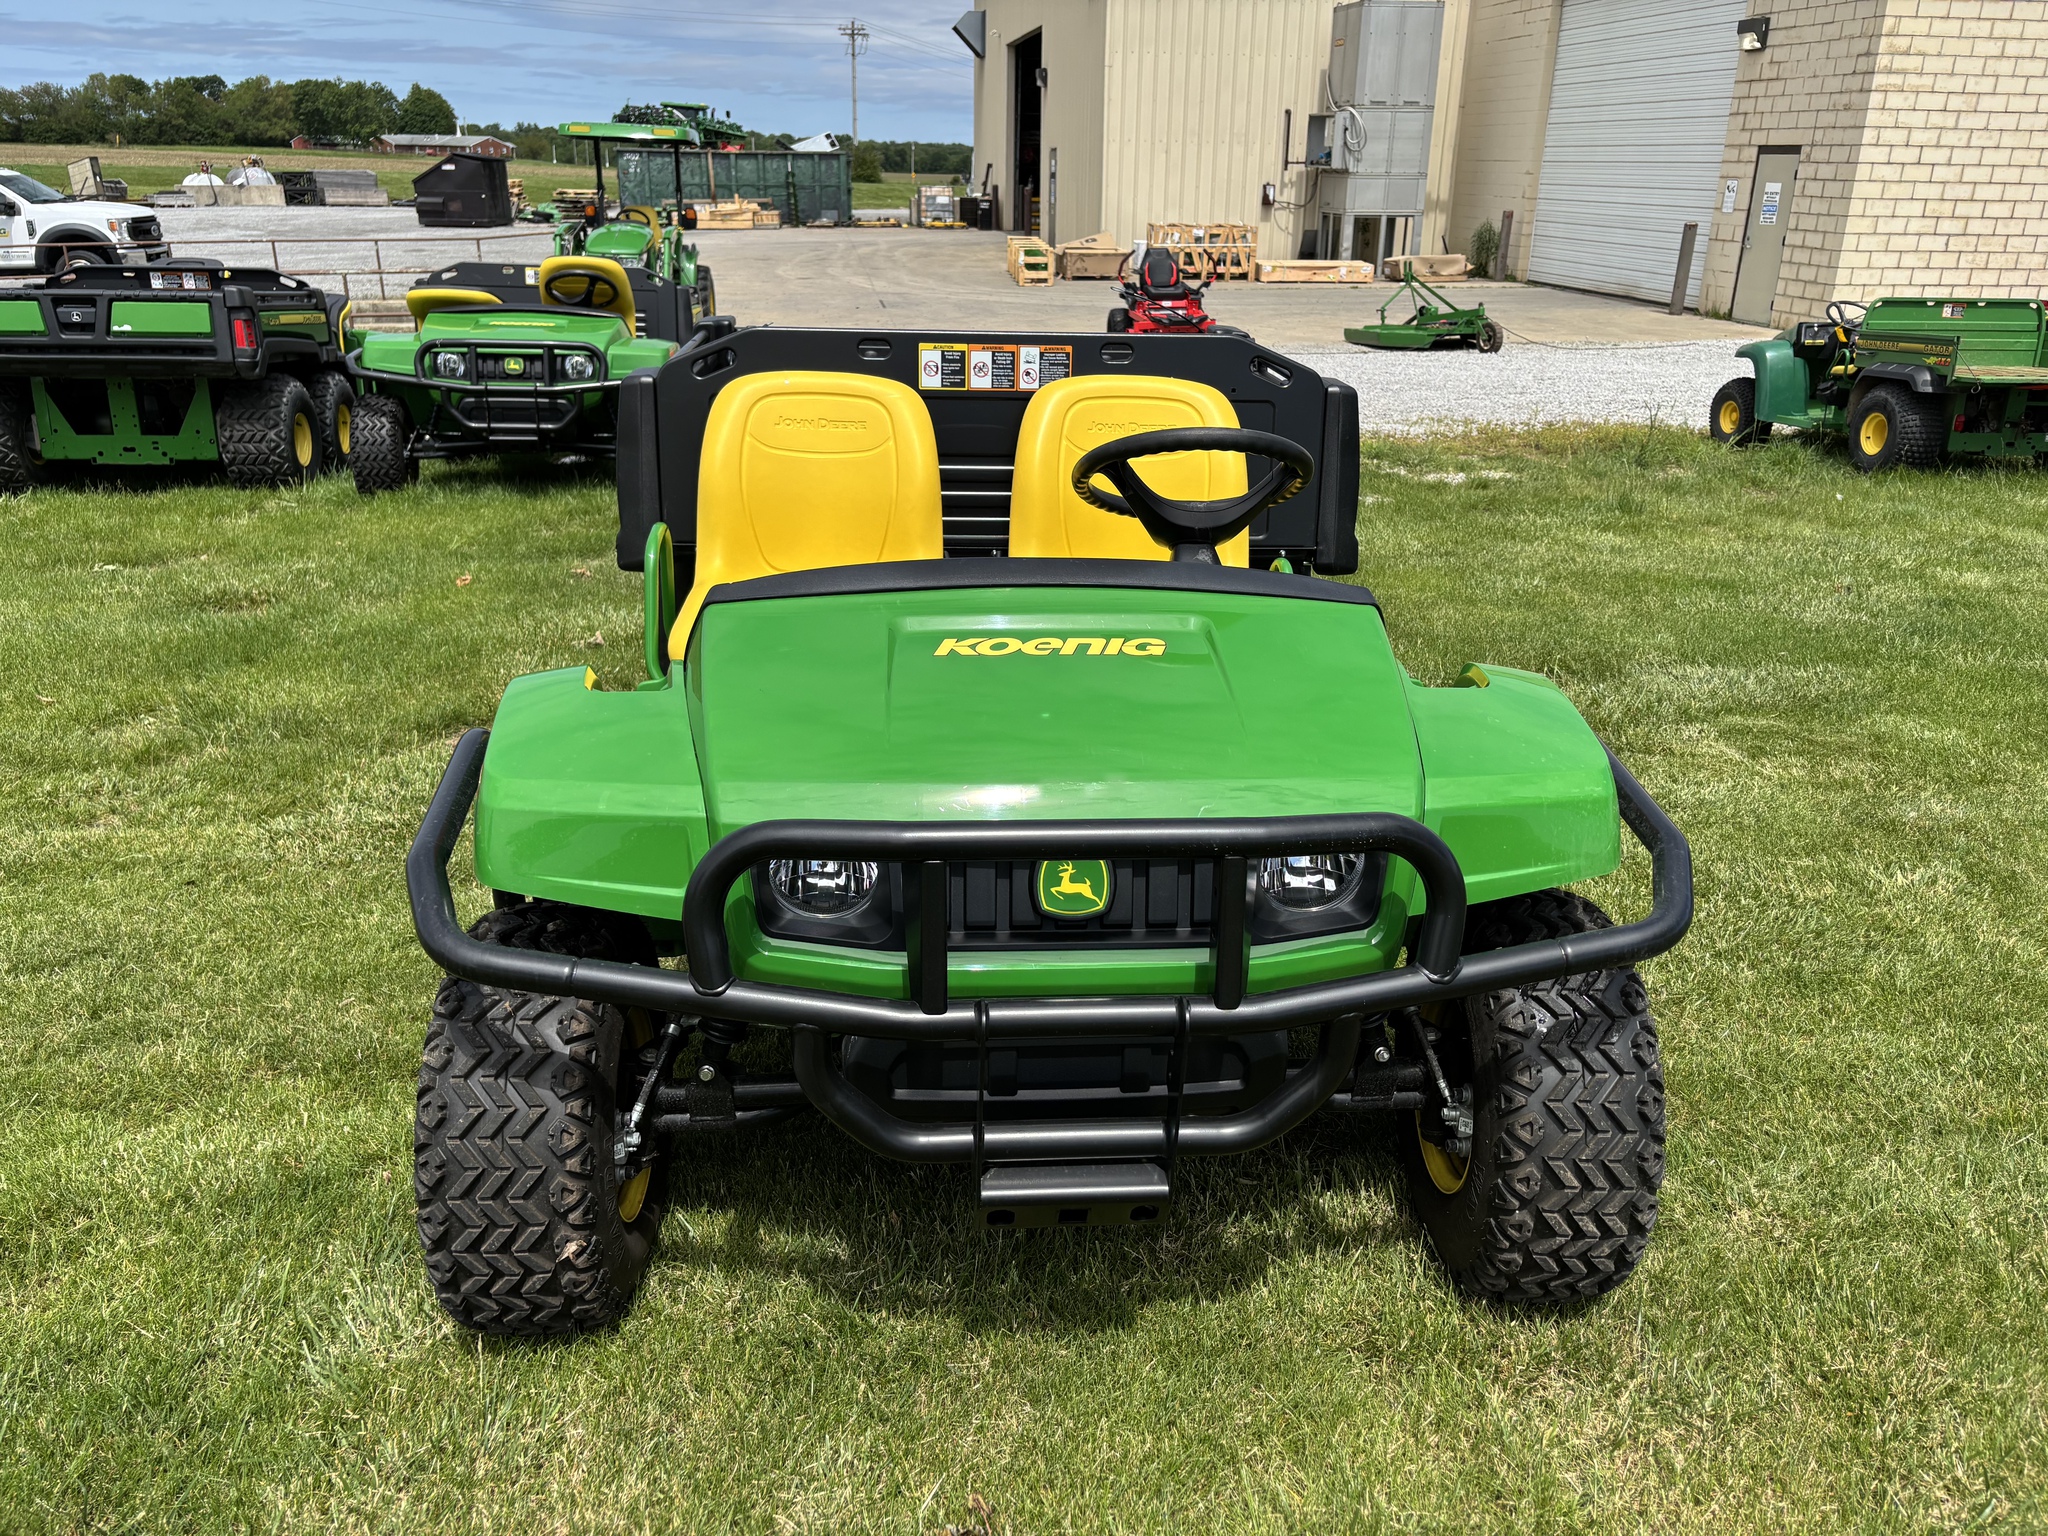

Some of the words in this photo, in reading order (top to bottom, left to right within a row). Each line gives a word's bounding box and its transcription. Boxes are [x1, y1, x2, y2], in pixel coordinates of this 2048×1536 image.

[1860, 340, 1878, 349] JOHN
[1878, 341, 1900, 350] DEERE
[1923, 345, 1951, 355] GATOR
[774, 415, 815, 430] JOHN
[818, 417, 867, 431] DEERE
[1087, 420, 1126, 434] JOHN
